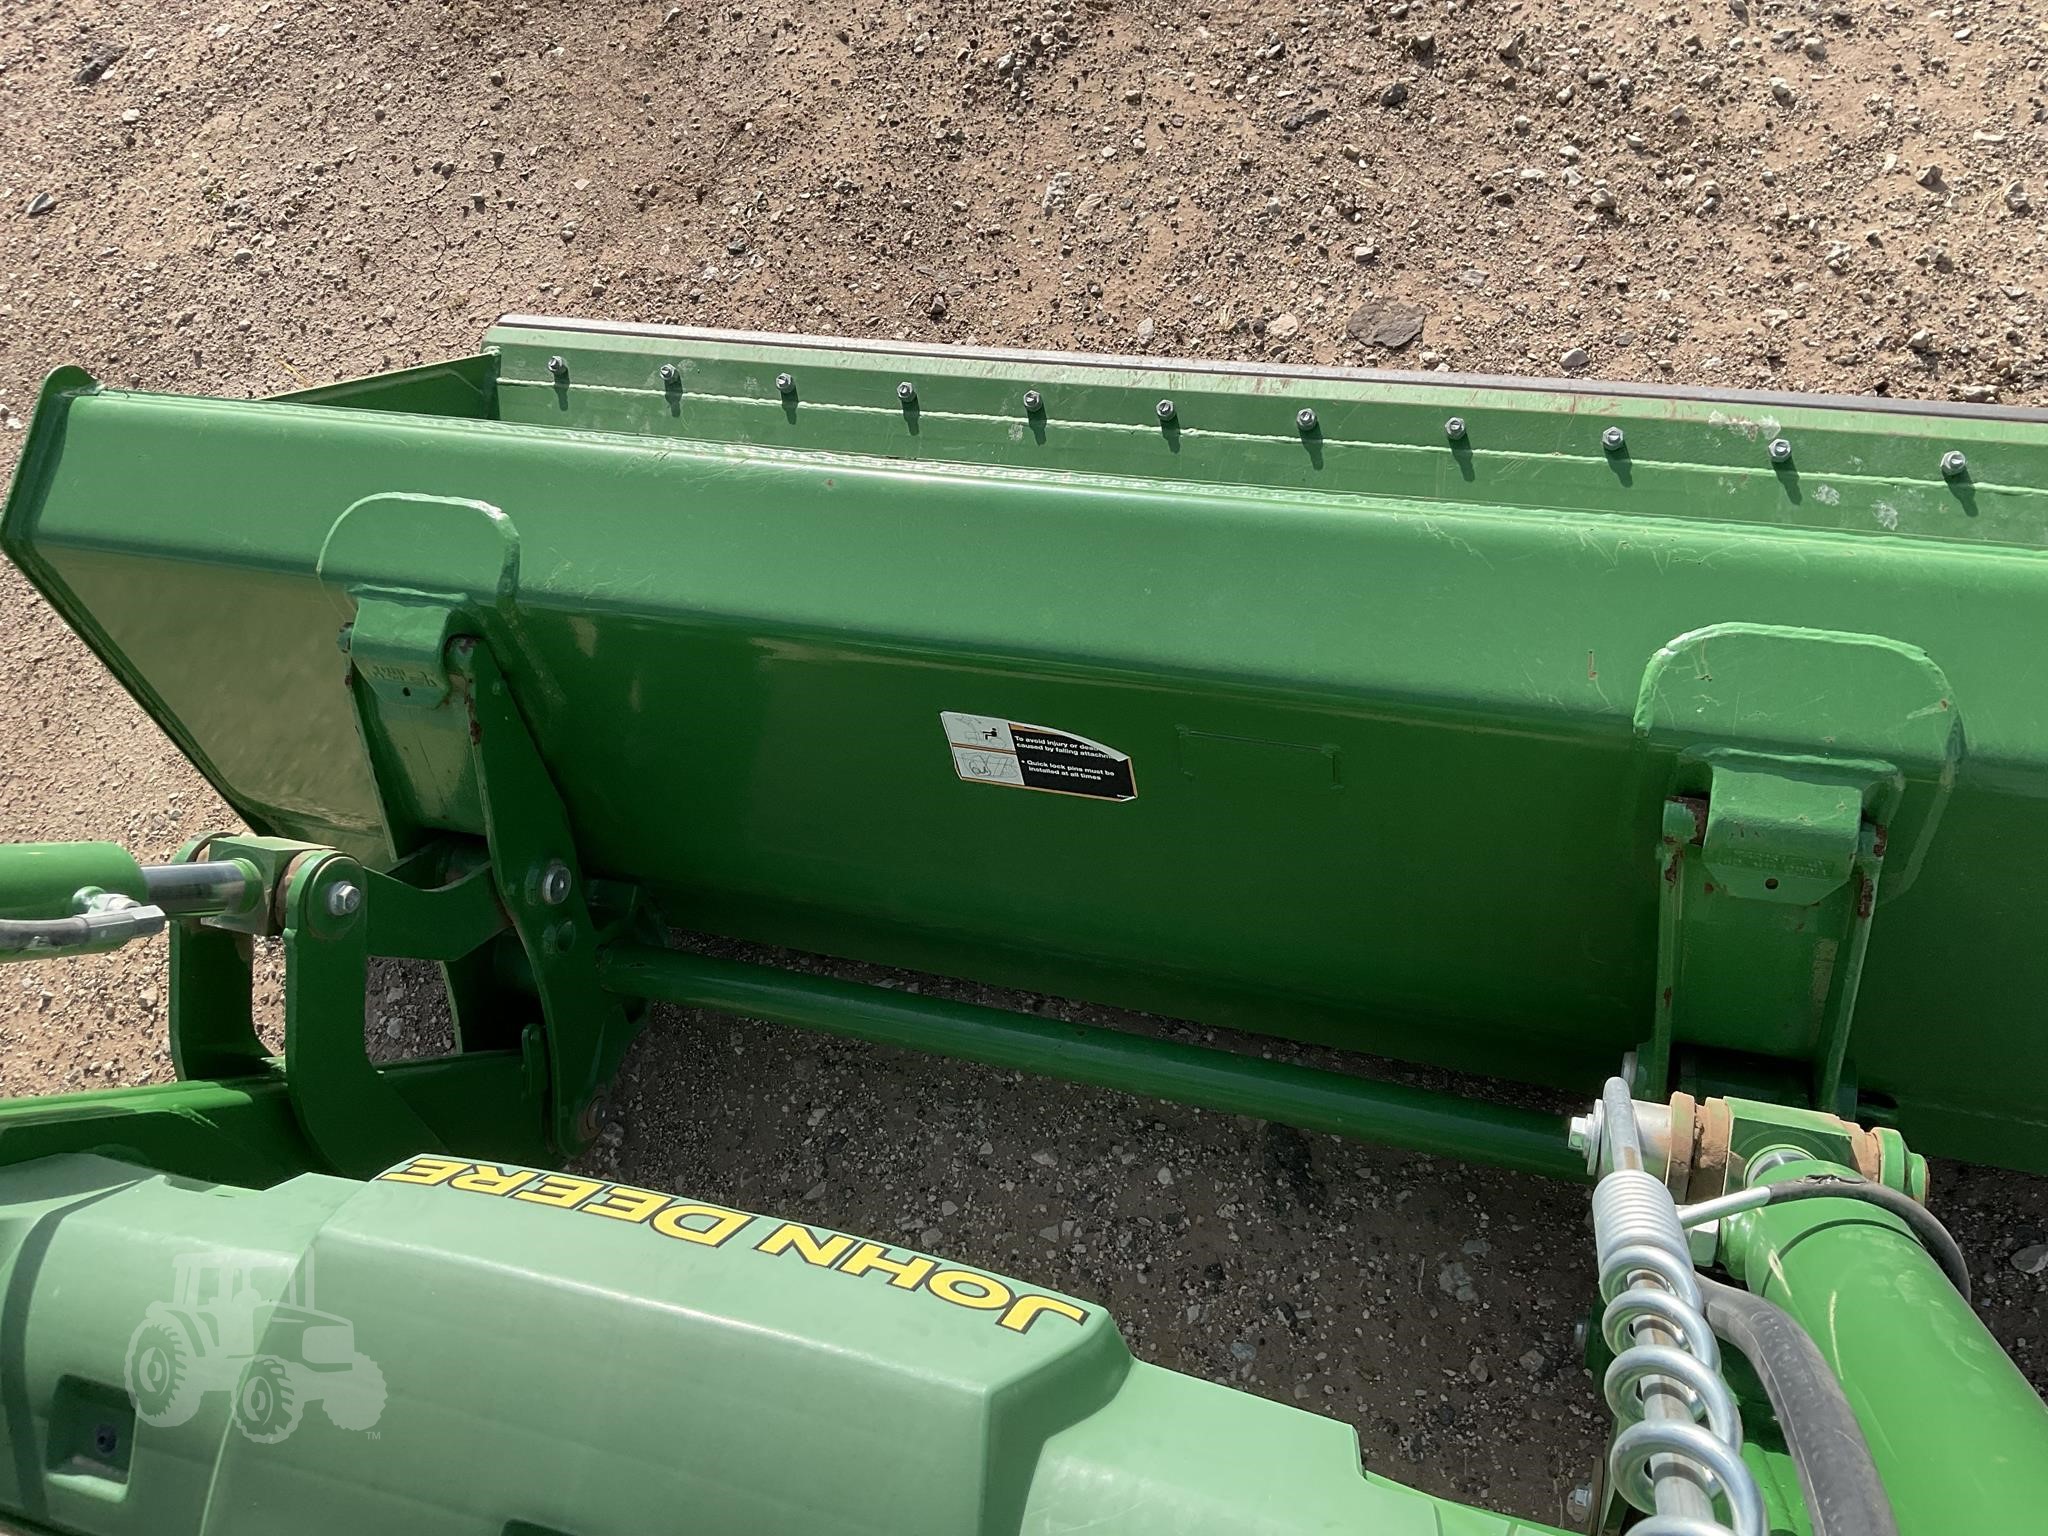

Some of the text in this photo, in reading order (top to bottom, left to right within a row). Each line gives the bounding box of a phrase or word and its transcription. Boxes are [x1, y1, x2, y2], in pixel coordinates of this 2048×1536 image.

[1047, 740, 1068, 748] injury
[1055, 747, 1078, 755] falling
[1028, 766, 1060, 775] installed
[380, 1157, 1091, 1334] JOHN DEERE
